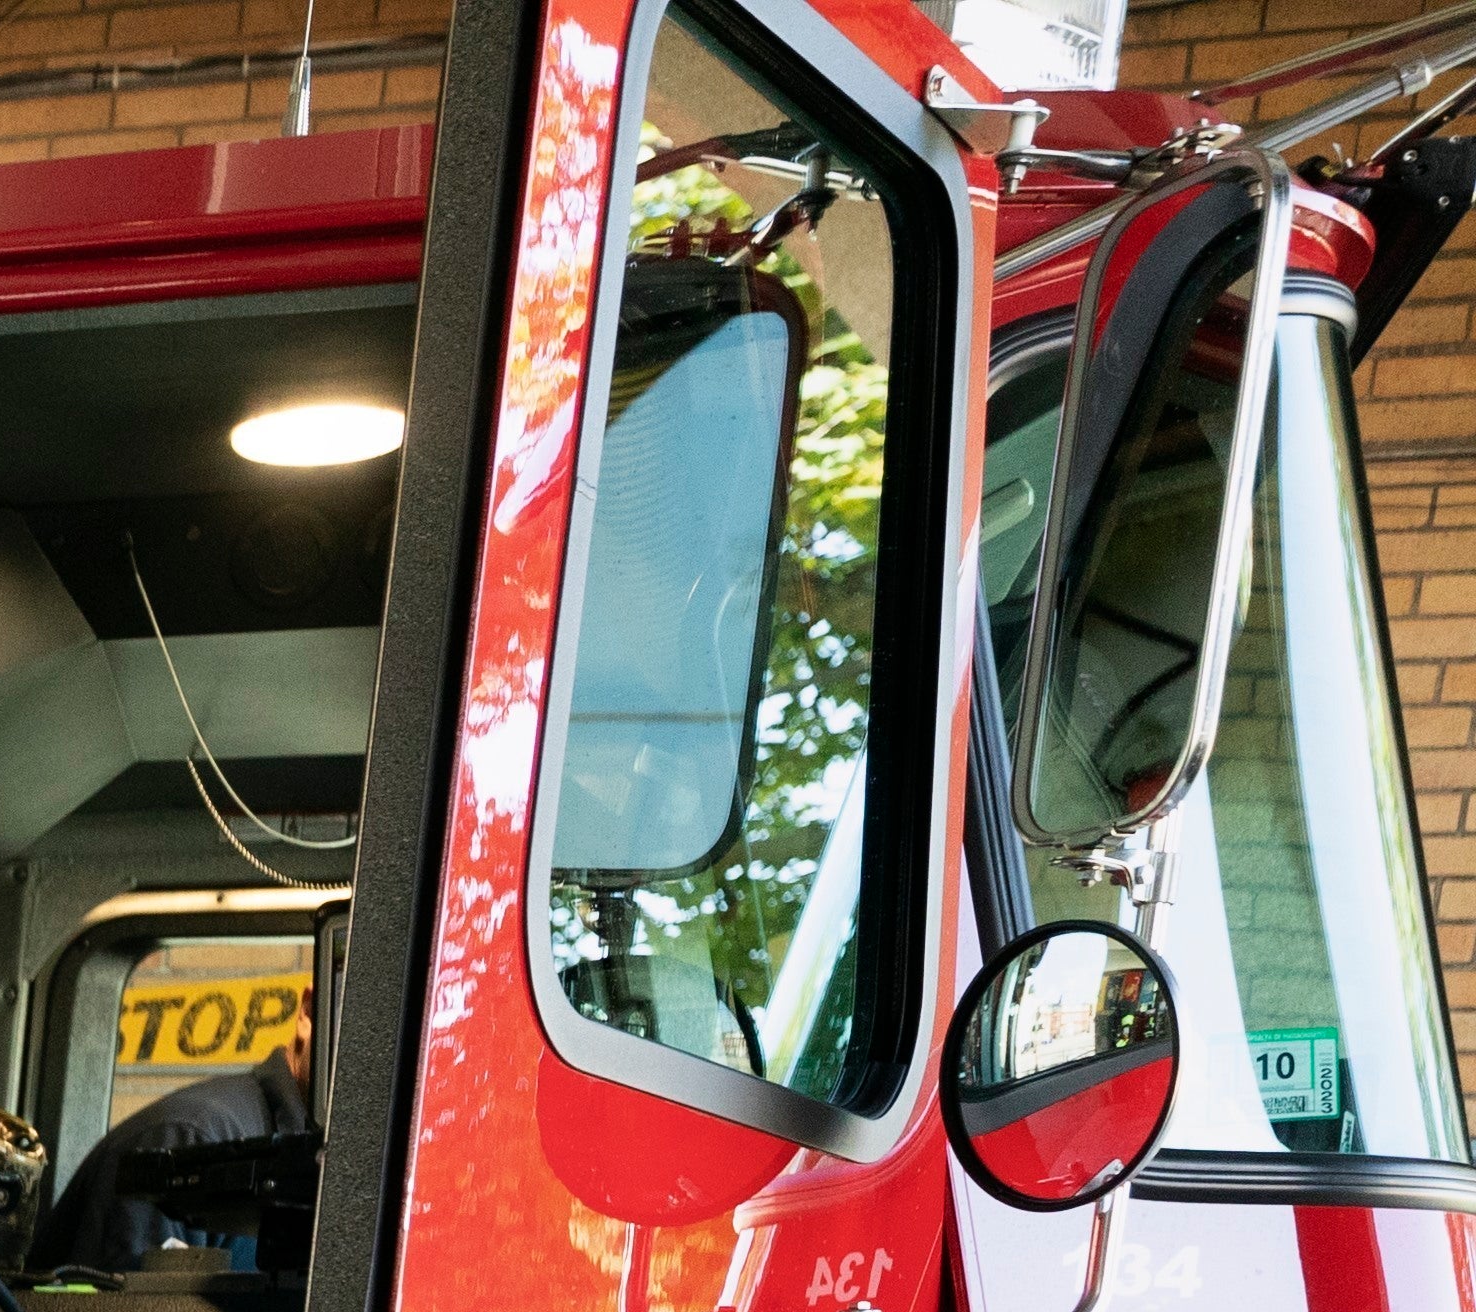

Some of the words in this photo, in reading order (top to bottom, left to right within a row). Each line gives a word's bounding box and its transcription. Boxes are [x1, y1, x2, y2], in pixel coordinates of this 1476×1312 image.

[117, 988, 298, 1058] TOP
[1256, 1052, 1295, 1080] 10
[1320, 1067, 1333, 1113] 2023
